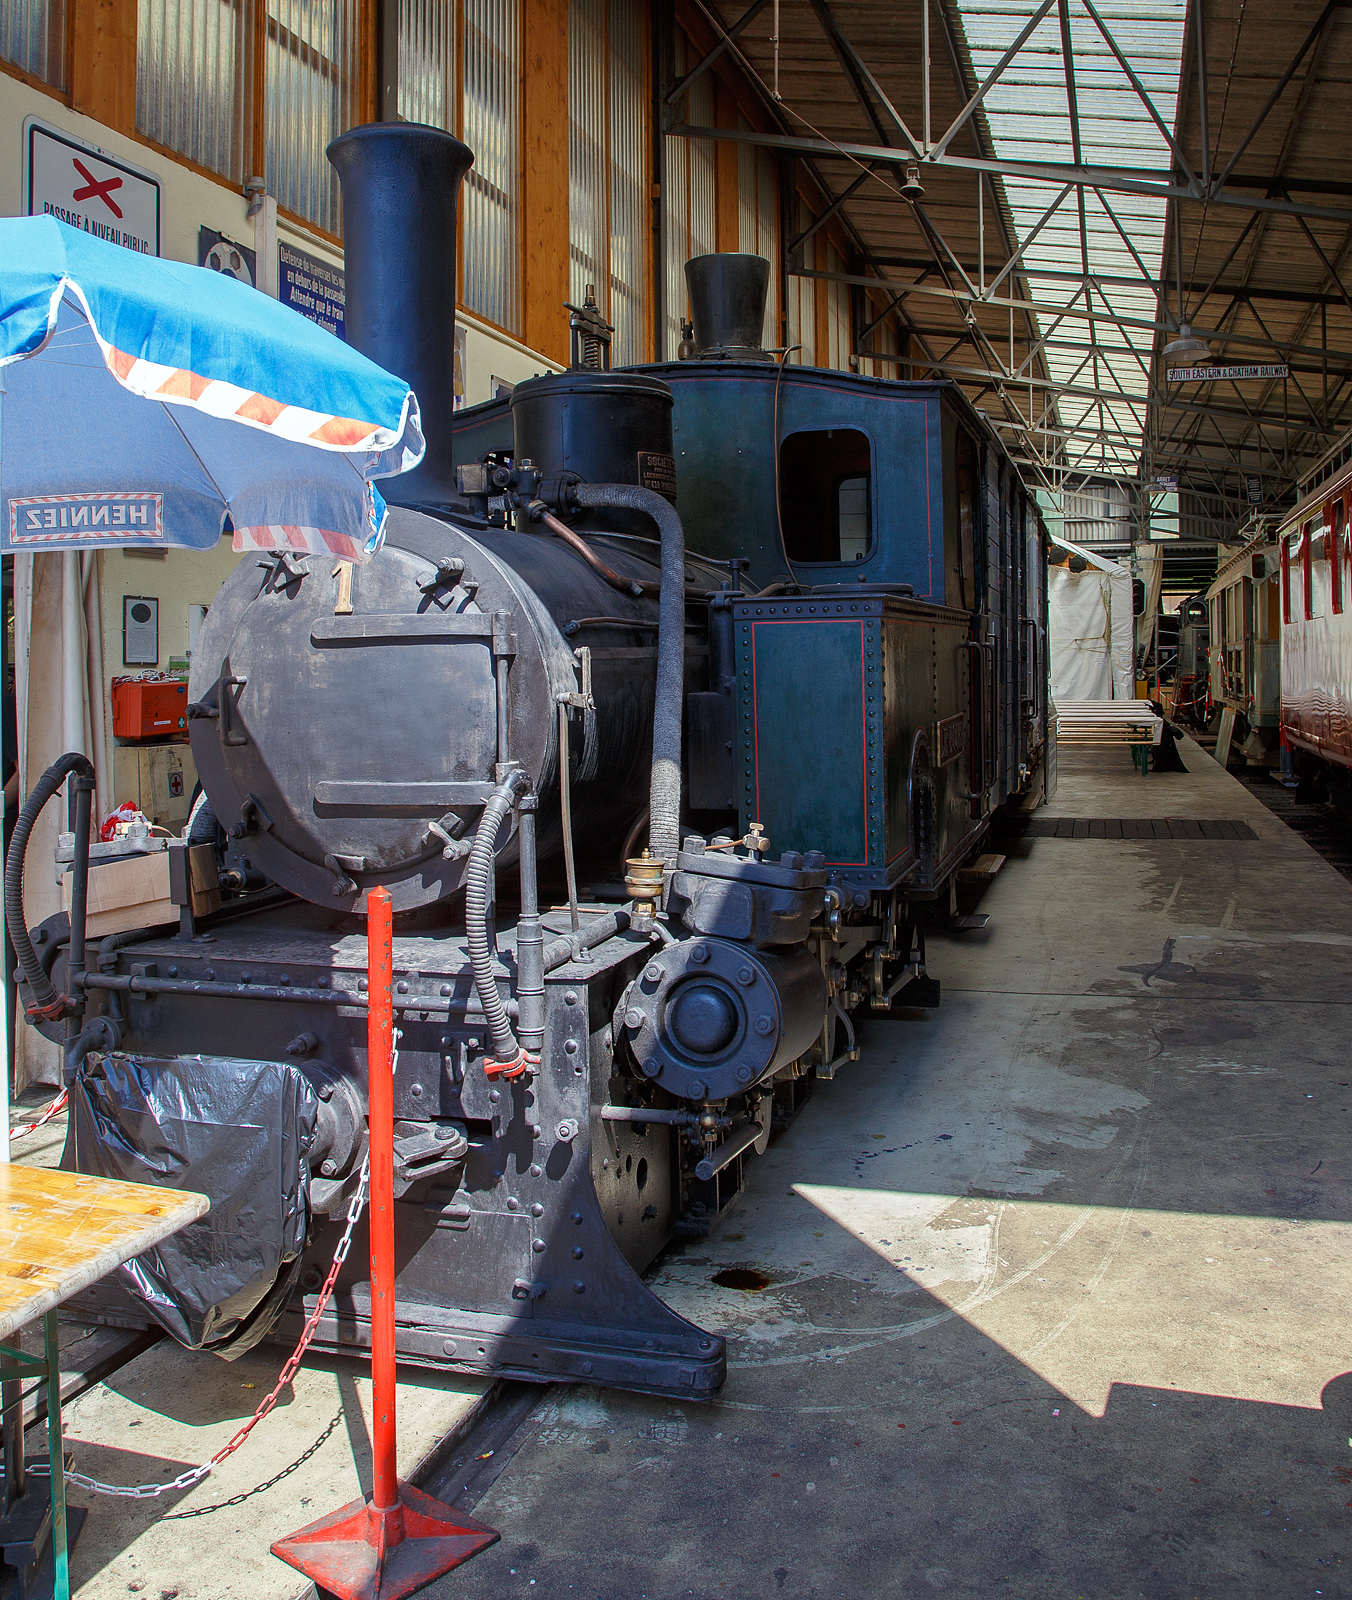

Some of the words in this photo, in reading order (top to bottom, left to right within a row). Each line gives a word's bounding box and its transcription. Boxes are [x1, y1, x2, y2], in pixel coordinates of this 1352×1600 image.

[44, 201, 81, 228] PASSAGE
[83, 214, 90, 233] À
[92, 220, 121, 245] NIVEAU
[123, 232, 149, 255] PUBLIC
[280, 246, 303, 270] Défense
[303, 257, 310, 273] de
[331, 270, 339, 286] les
[287, 270, 295, 284] en
[295, 270, 312, 290] dehors
[312, 278, 319, 294] de
[319, 280, 324, 296] la
[290, 286, 315, 309] Attendre
[315, 300, 326, 314] que
[326, 300, 331, 316] le
[332, 304, 344, 321] train
[1169, 369, 1191, 380] SOUTH
[1192, 368, 1222, 379] EASTERN
[1222, 369, 1228, 378] &
[1228, 367, 1258, 377] CHATHAM
[1260, 366, 1288, 377] RAILWAY
[331, 560, 355, 616] 1
